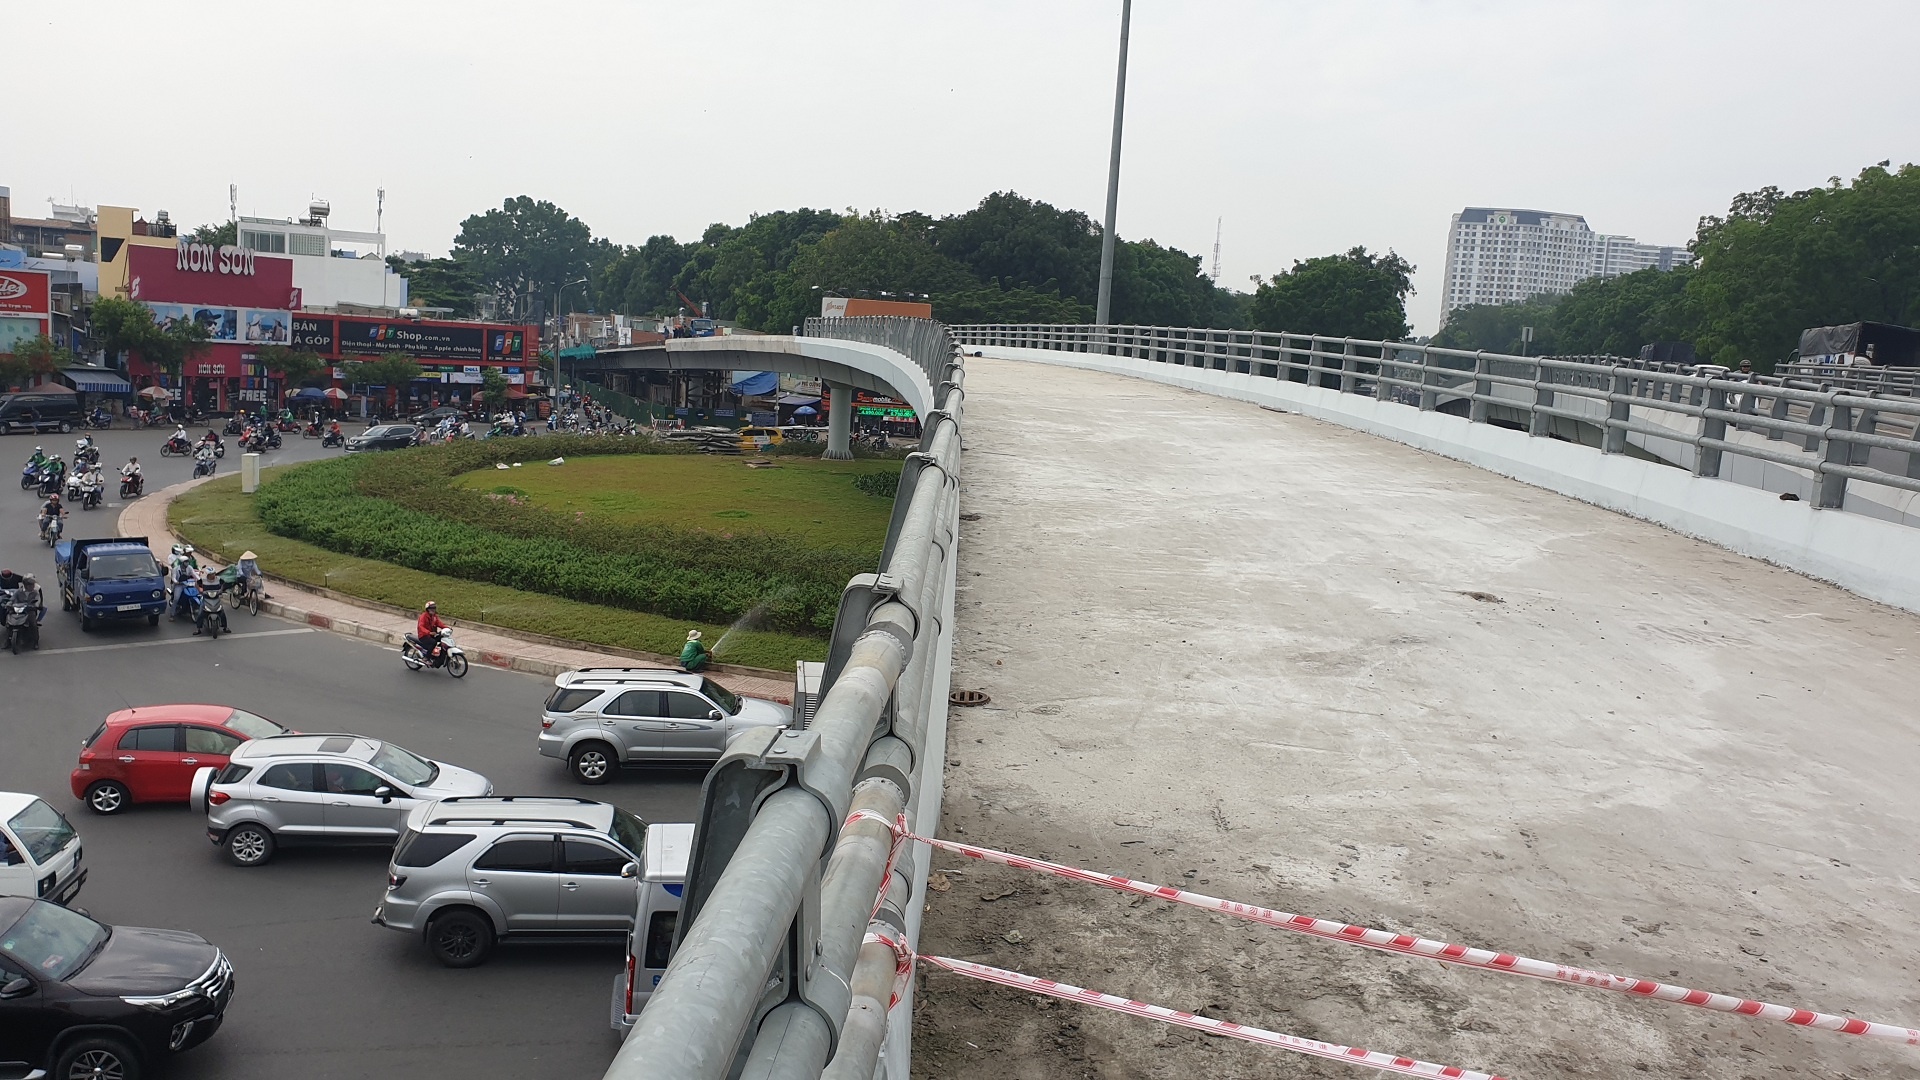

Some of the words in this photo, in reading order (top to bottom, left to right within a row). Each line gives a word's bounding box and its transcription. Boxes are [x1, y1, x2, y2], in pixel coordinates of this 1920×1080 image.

[293, 320, 317, 332] BÁN
[305, 334, 330, 345] GÓP
[397, 331, 450, 342] Shop.com.vn
[239, 389, 267, 402] FREE
